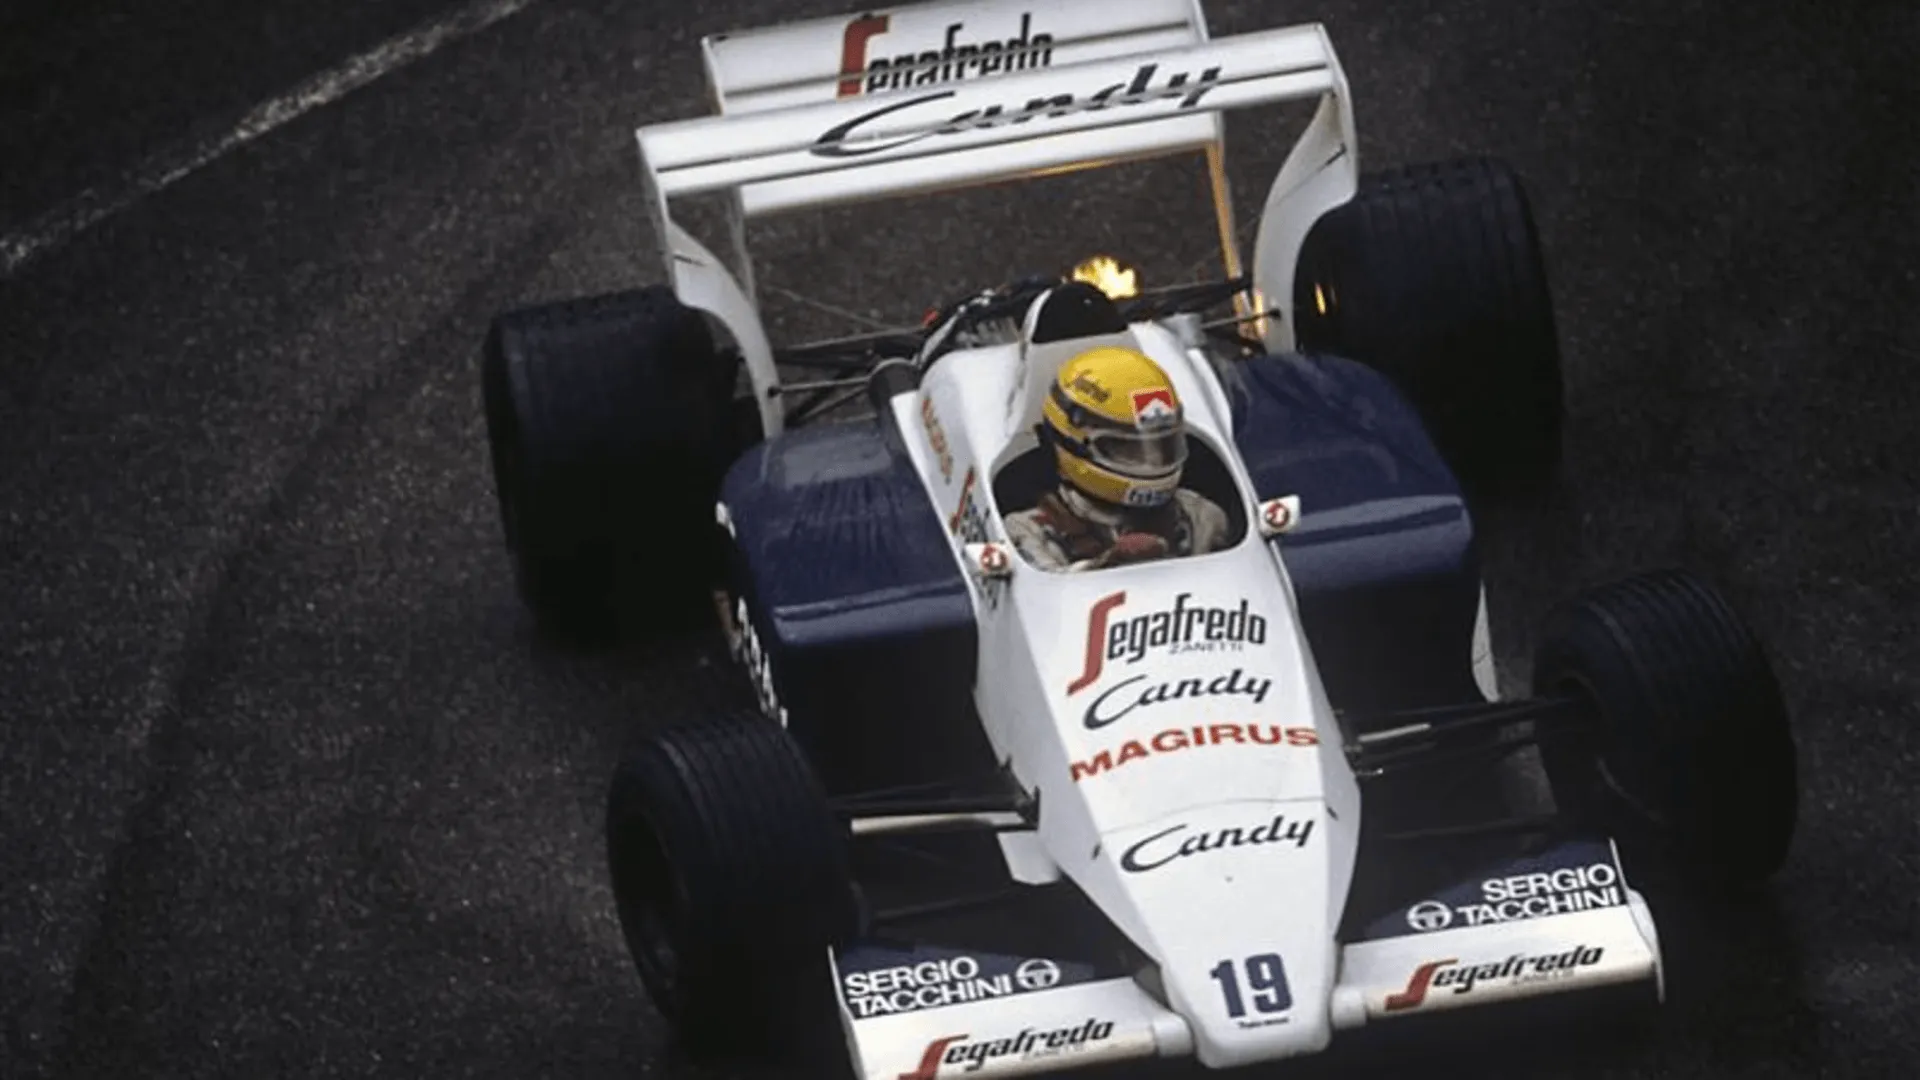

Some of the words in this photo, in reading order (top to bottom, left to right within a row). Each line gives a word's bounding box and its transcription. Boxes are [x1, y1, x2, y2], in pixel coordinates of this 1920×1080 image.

[811, 64, 1222, 157] Candy
[1067, 590, 1267, 696] Segafredo
[1083, 669, 1272, 729] Candy
[1069, 723, 1321, 783] MAGIRUS
[1120, 815, 1315, 873] Candy
[1456, 887, 1620, 926] TACCHINI
[1481, 863, 1616, 901] SERGIO
[845, 956, 979, 997] SERGIO
[850, 974, 1013, 1017] TACCHINI
[1209, 952, 1293, 1018] 19
[1384, 945, 1605, 1012] Segafredo
[897, 1018, 1114, 1080] Segafredo
